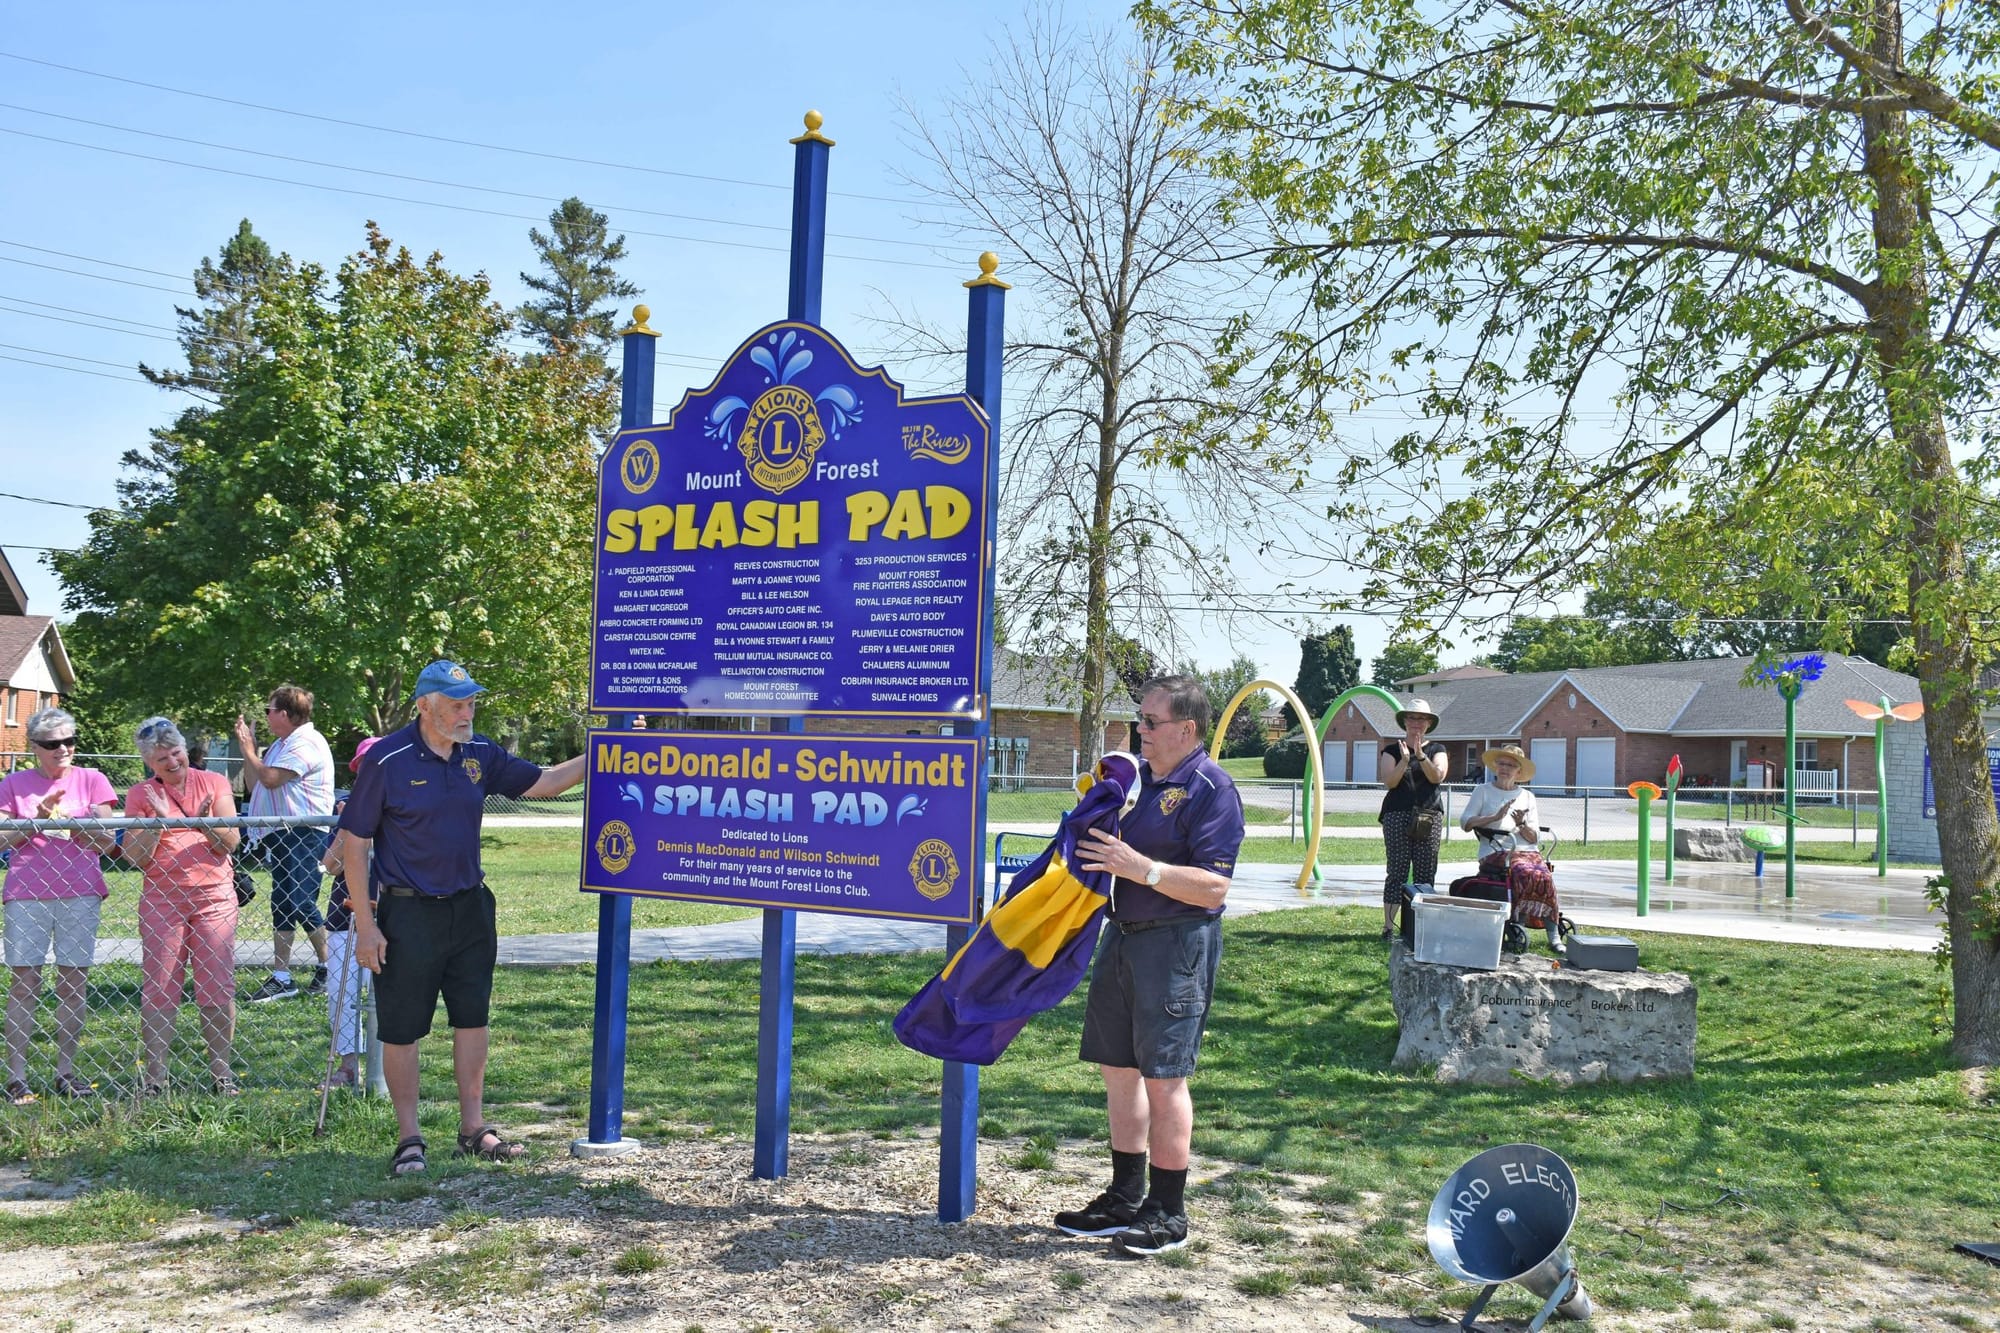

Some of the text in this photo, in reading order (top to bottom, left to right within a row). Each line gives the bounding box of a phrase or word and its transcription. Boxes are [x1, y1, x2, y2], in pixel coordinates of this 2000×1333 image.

[760, 392, 807, 414] LIONS
[772, 420, 792, 455] L
[902, 424, 960, 450] The River
[686, 459, 879, 491] Mount Forest
[757, 464, 803, 483] INTERNATIONAL
[604, 486, 972, 553] SPLASH PAD
[874, 555, 925, 564] PRODUCTION
[927, 553, 967, 562] SERVICES
[615, 567, 644, 575] PADFIELD
[646, 565, 696, 574] PROFESSIONAL
[734, 560, 819, 570] REEVES CONSTRUCTION
[628, 575, 674, 583] CORPORATION
[732, 575, 820, 585] MARTY & JOANNE YOUNG
[879, 570, 940, 580] MOUNT FOREST
[853, 579, 966, 590] FIRE FIGHTERS ASSOCIATION
[742, 592, 756, 600] BILL
[765, 591, 777, 599] LEE
[780, 591, 809, 599] NELSON
[856, 596, 963, 606] ROYAL LEPAGE RCR REALTY
[650, 603, 688, 611] MCGREGOR
[728, 607, 763, 615] OFFICER'S
[786, 606, 805, 614] CARE
[871, 612, 945, 621] DAVE'S AUTO BODY
[659, 618, 689, 626] FORMING
[740, 622, 776, 630] CANADIAN
[807, 621, 819, 629] BR.
[822, 621, 833, 629] 134
[852, 628, 964, 637] PLUMEVILLE CONSTRUCTION
[737, 637, 765, 645] YVONNE
[767, 637, 800, 645] STEWART
[809, 636, 834, 644] FAMILY
[859, 645, 884, 653] JERRY
[886, 645, 890, 653] &
[893, 645, 928, 653] MELANIE
[747, 652, 775, 660] MUTUAL
[777, 652, 818, 660] INSURANCE
[863, 661, 949, 669] CHALMERS ALUMINUM
[841, 677, 872, 685] COBURN
[875, 677, 917, 685] INSURANCE
[920, 677, 951, 685] BROKER
[725, 692, 773, 700] HOMECOMING
[872, 693, 907, 701] SUNVALE
[597, 744, 771, 779] MacDonald
[795, 750, 965, 788] Schwindt
[652, 784, 888, 827] SPLASH PAD
[606, 824, 628, 835] LIONS
[722, 828, 808, 843] Dedicated to Lions
[658, 840, 880, 866] Dennis MacDonald and Wilson Schwindt
[921, 843, 948, 854] LIONS
[680, 858, 852, 880] For their many years of service to the
[663, 871, 870, 897] community and the Mount Forest Lions Club.
[1481, 995, 1521, 1005] Coburn
[1636, 1001, 1656, 1012] Ltd.
[1445, 1178, 1490, 1241] WARD
